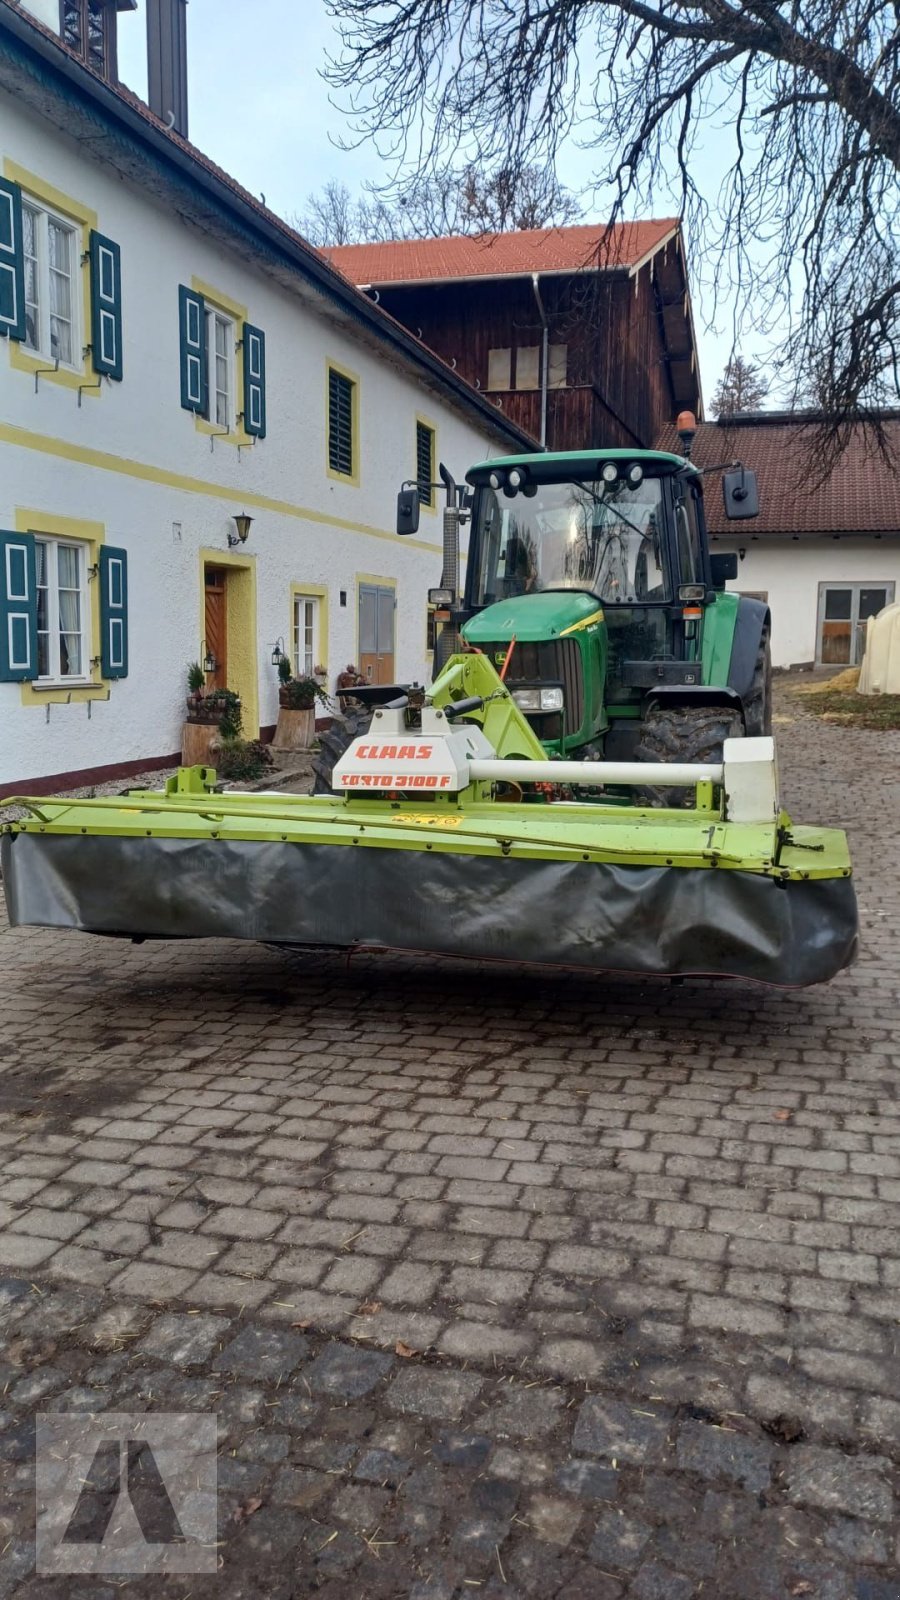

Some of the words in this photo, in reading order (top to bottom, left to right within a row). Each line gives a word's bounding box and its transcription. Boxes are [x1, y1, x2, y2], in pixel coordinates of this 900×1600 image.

[355, 746, 432, 759] CLAAS
[396, 775, 438, 787] 3100
[440, 776, 451, 787] F
